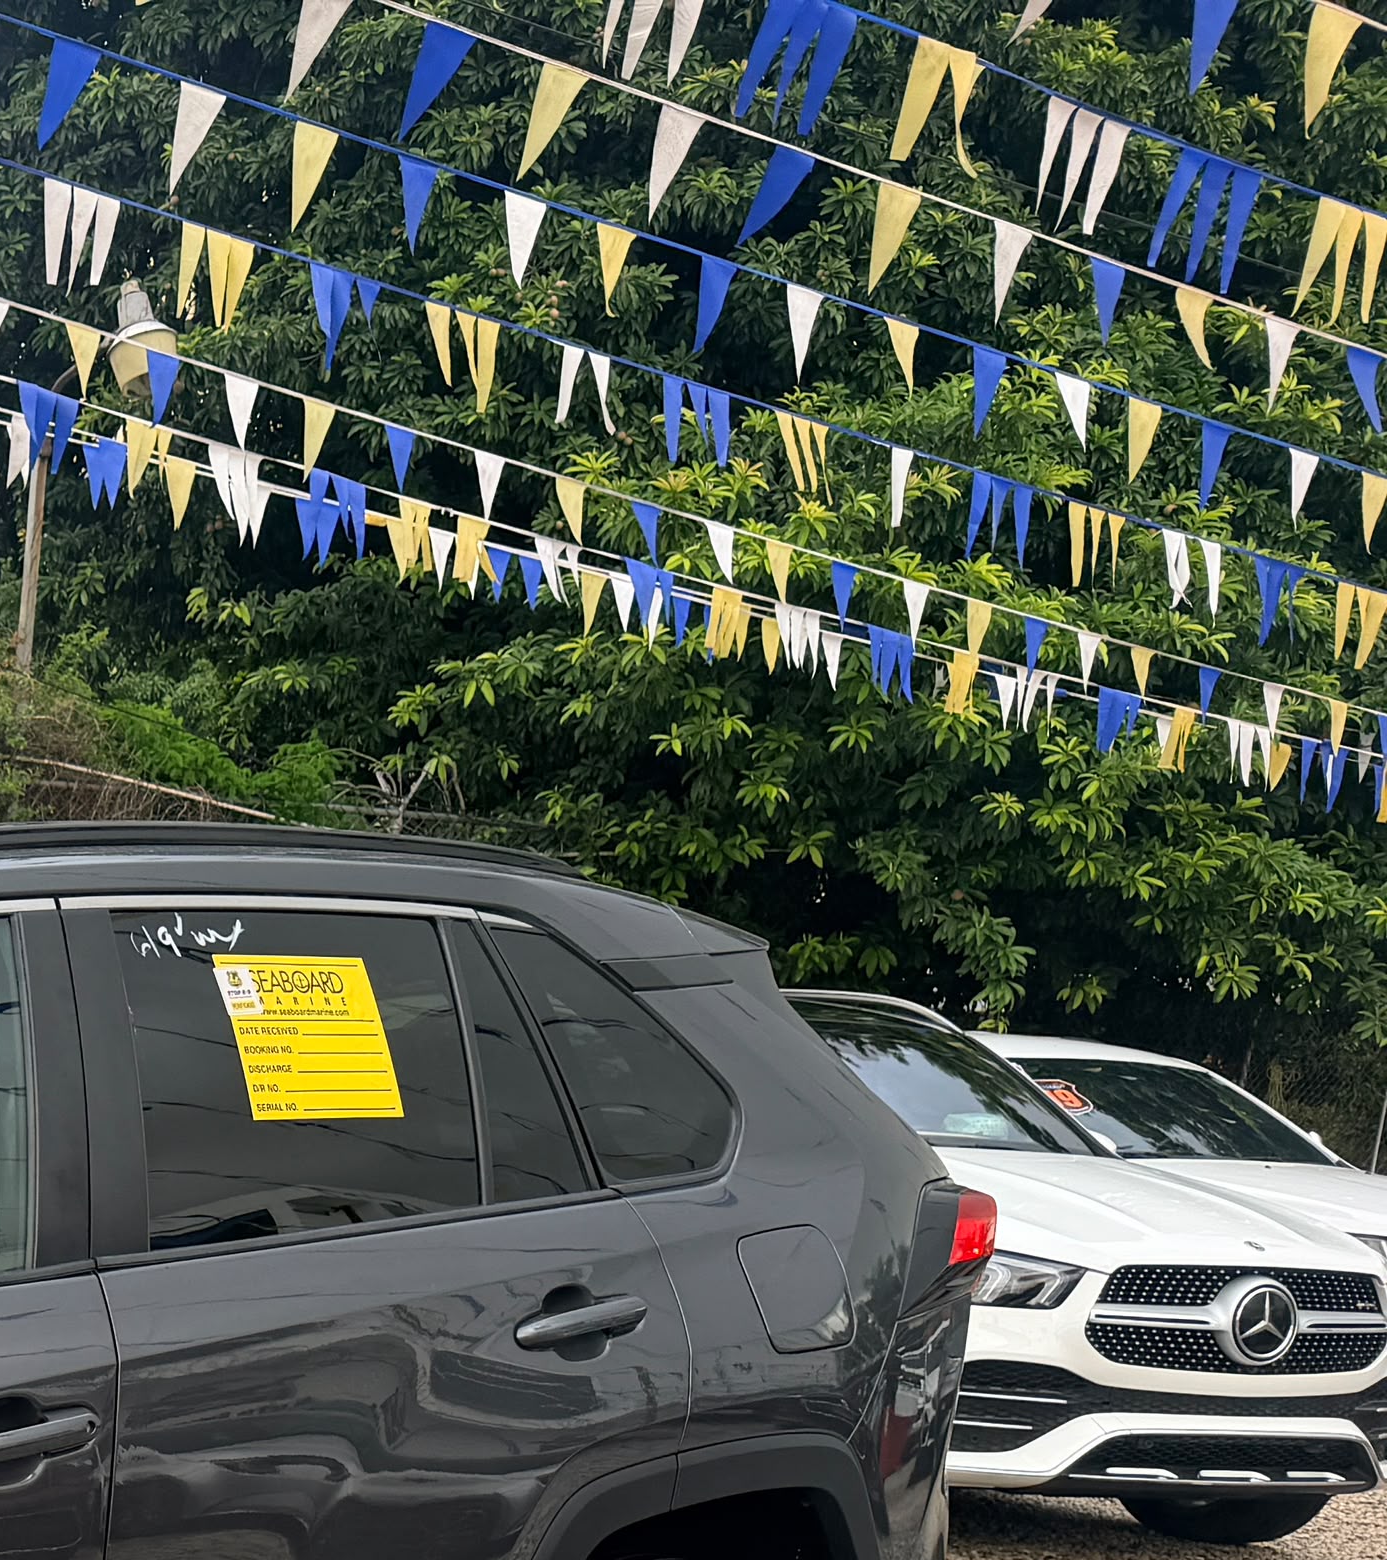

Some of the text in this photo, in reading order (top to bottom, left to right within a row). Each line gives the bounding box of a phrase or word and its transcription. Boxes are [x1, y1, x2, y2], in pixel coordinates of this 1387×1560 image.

[248, 969, 344, 994] SEABOARD
[239, 1027, 299, 1035] DATE RECEIVED
[244, 1046, 295, 1054] BOOKING NO.
[248, 1065, 292, 1073] DISCHARGE
[267, 1084, 281, 1092] NO.
[256, 1103, 299, 1112] SERIAL NO.
